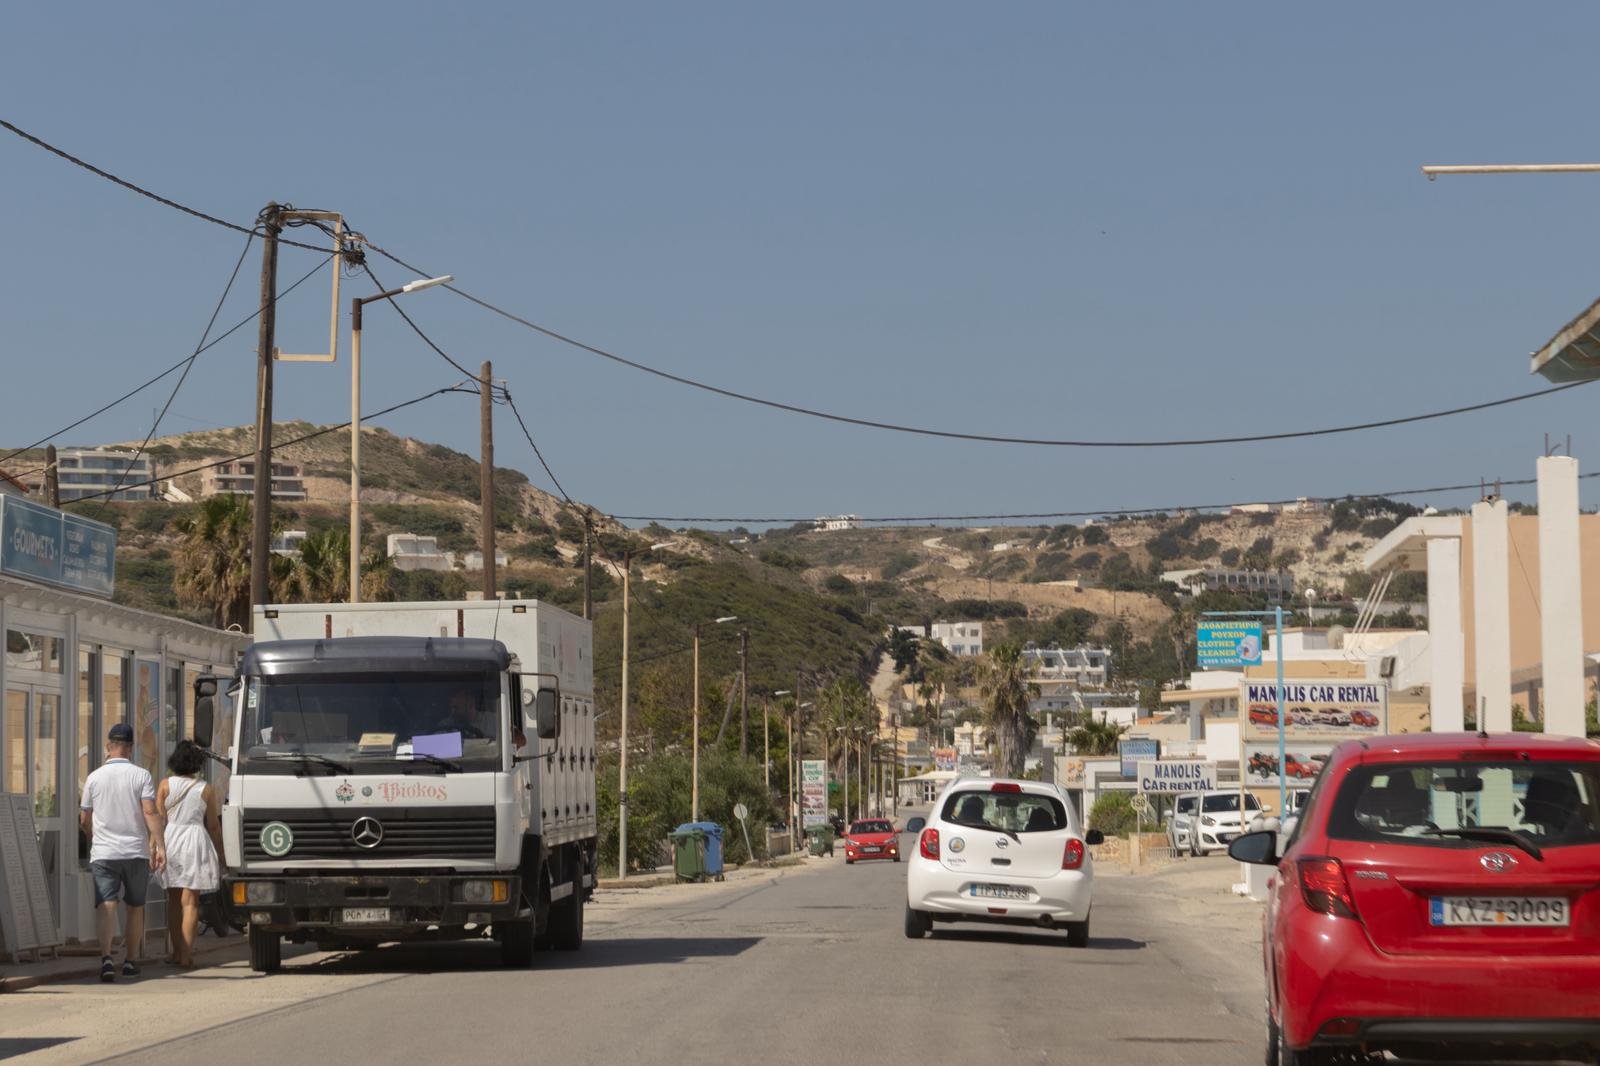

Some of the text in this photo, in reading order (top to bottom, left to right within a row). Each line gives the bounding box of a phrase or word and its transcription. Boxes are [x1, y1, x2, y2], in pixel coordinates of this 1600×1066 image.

[1310, 686, 1334, 703] CAR
[1338, 686, 1379, 703] RENTAL
[1154, 764, 1201, 778] MANOLIS
[1143, 778, 1214, 791] CAR RENTAL
[270, 829, 284, 848] G
